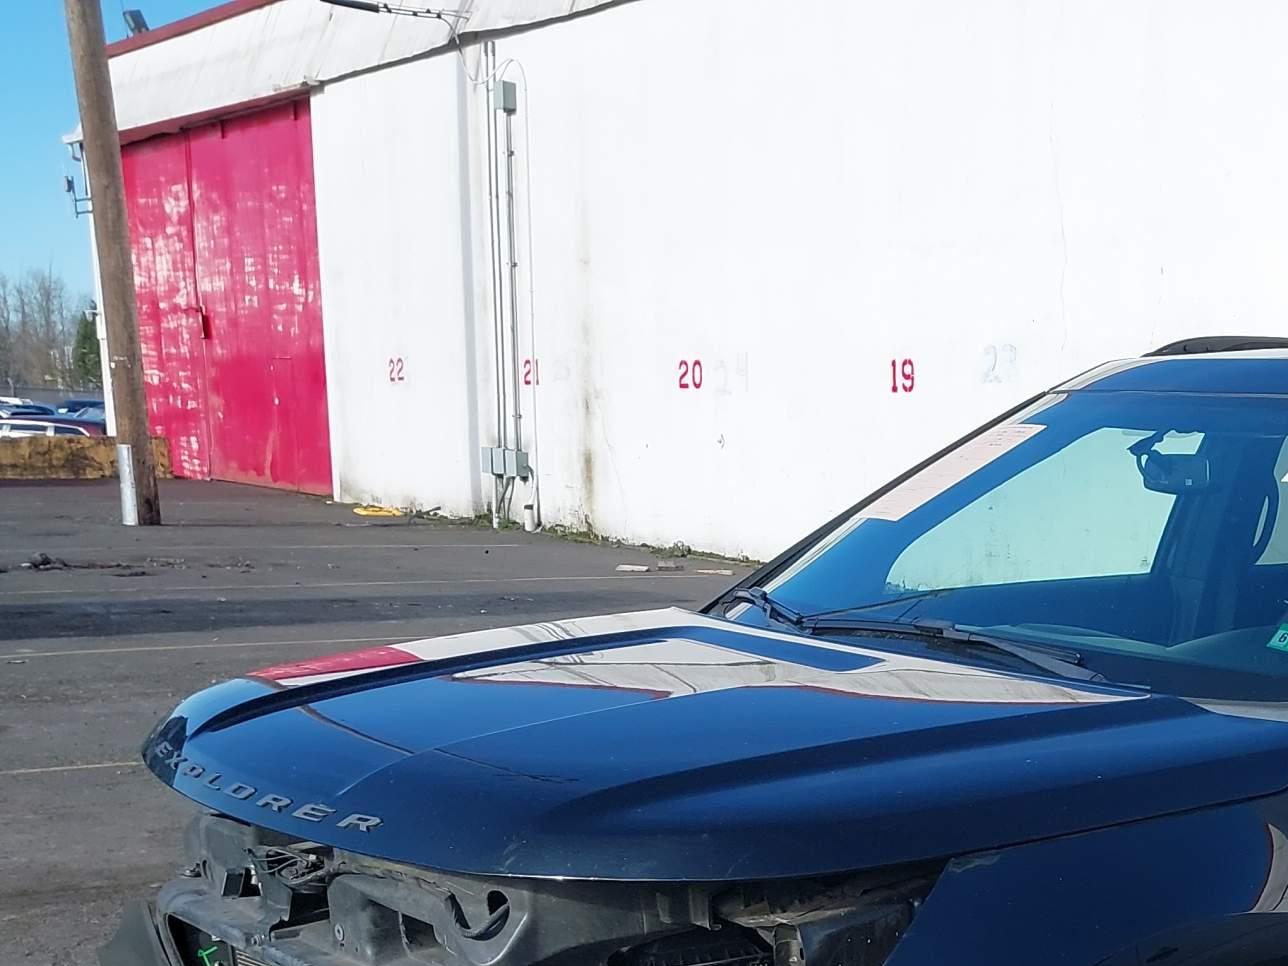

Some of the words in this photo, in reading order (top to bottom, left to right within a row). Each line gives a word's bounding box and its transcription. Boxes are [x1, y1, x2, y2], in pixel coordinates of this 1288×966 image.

[389, 357, 405, 382] 22
[523, 358, 540, 386] 21
[678, 359, 703, 389] 20
[891, 358, 915, 393] 19
[1279, 632, 1288, 643] 6
[155, 740, 385, 833] EXPLORER
